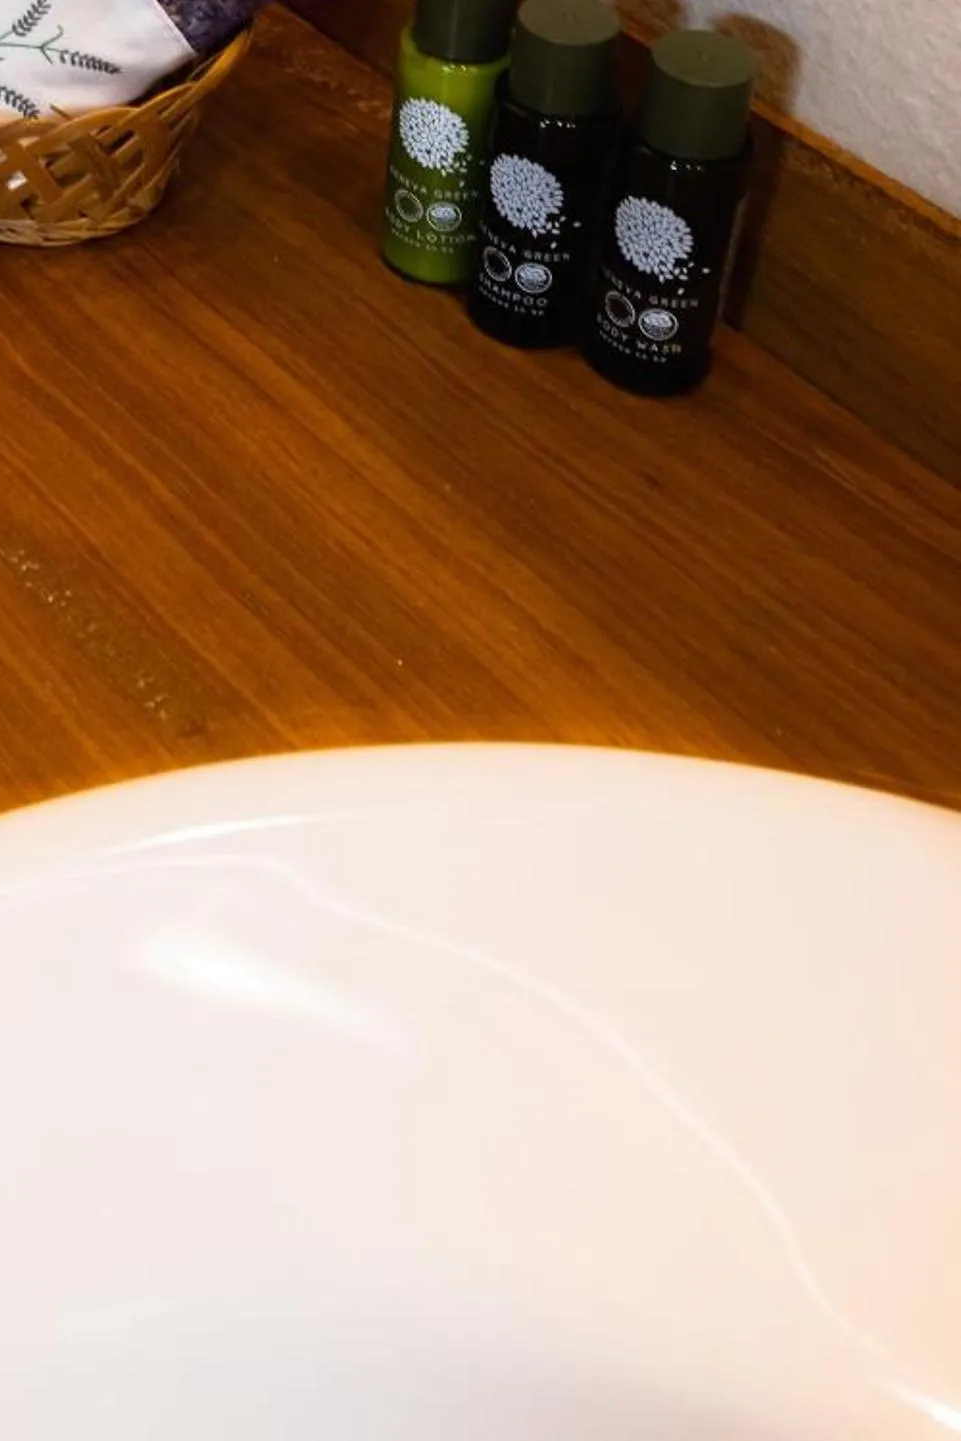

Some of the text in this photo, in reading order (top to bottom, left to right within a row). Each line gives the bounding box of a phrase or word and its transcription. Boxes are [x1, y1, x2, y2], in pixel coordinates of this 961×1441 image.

[416, 229, 477, 245] LOTION
[522, 249, 571, 264] GREEN
[647, 294, 700, 310] GREEN
[636, 339, 683, 356] WASH
